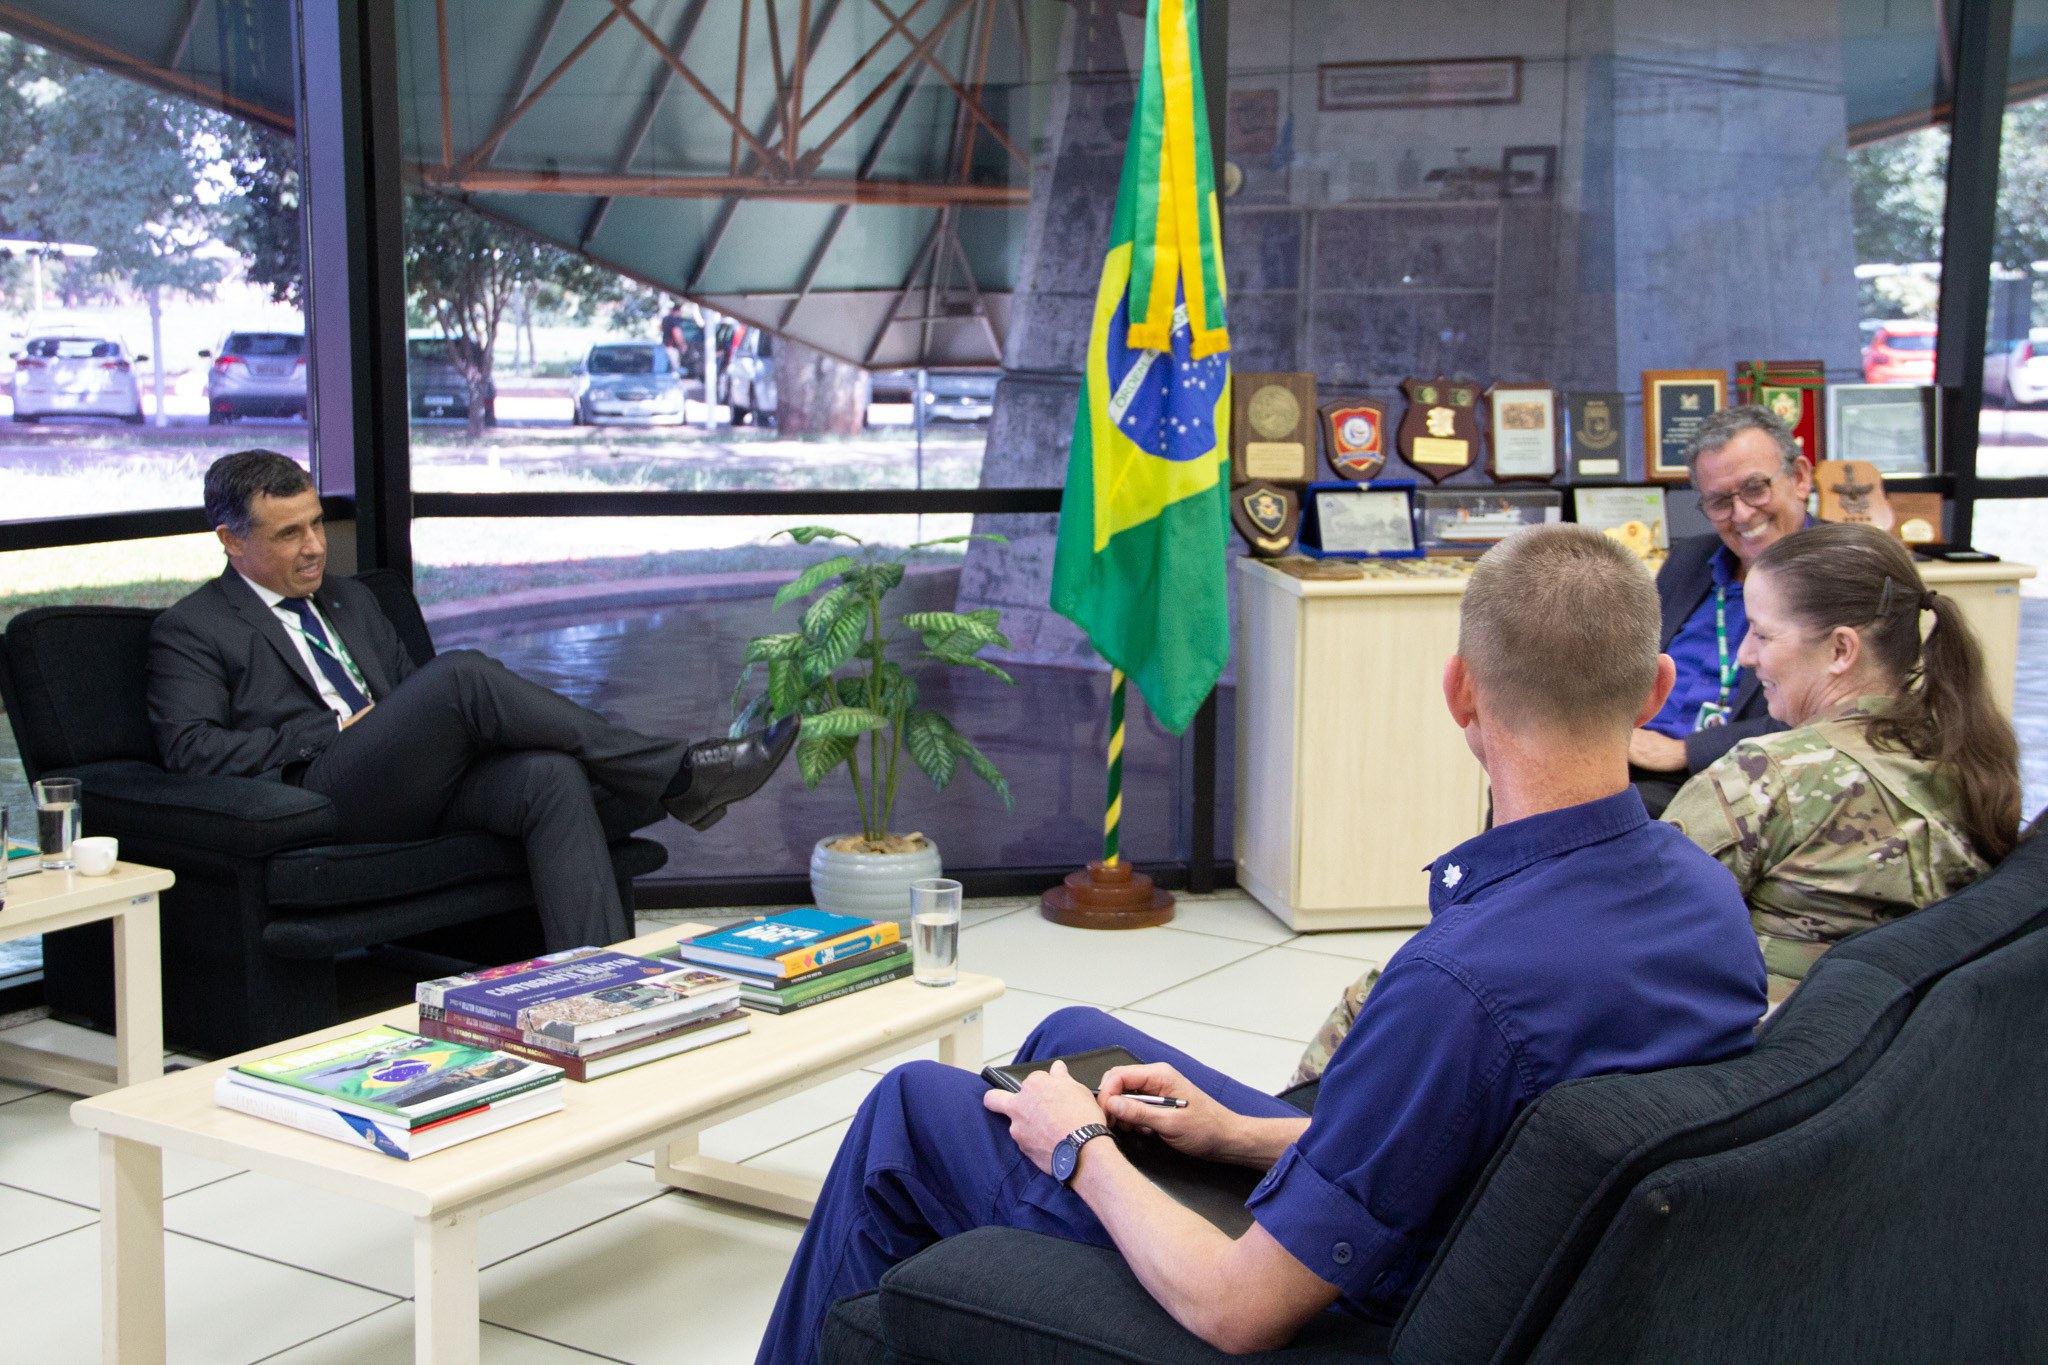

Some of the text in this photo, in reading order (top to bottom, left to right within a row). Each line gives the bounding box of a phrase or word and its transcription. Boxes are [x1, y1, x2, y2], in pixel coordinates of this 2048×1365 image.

[1115, 361, 1149, 409] ORDEM
[453, 1028, 472, 1038] ESTADO
[472, 1033, 489, 1043] MAYOR
[504, 1041, 527, 1053] DEFENSA
